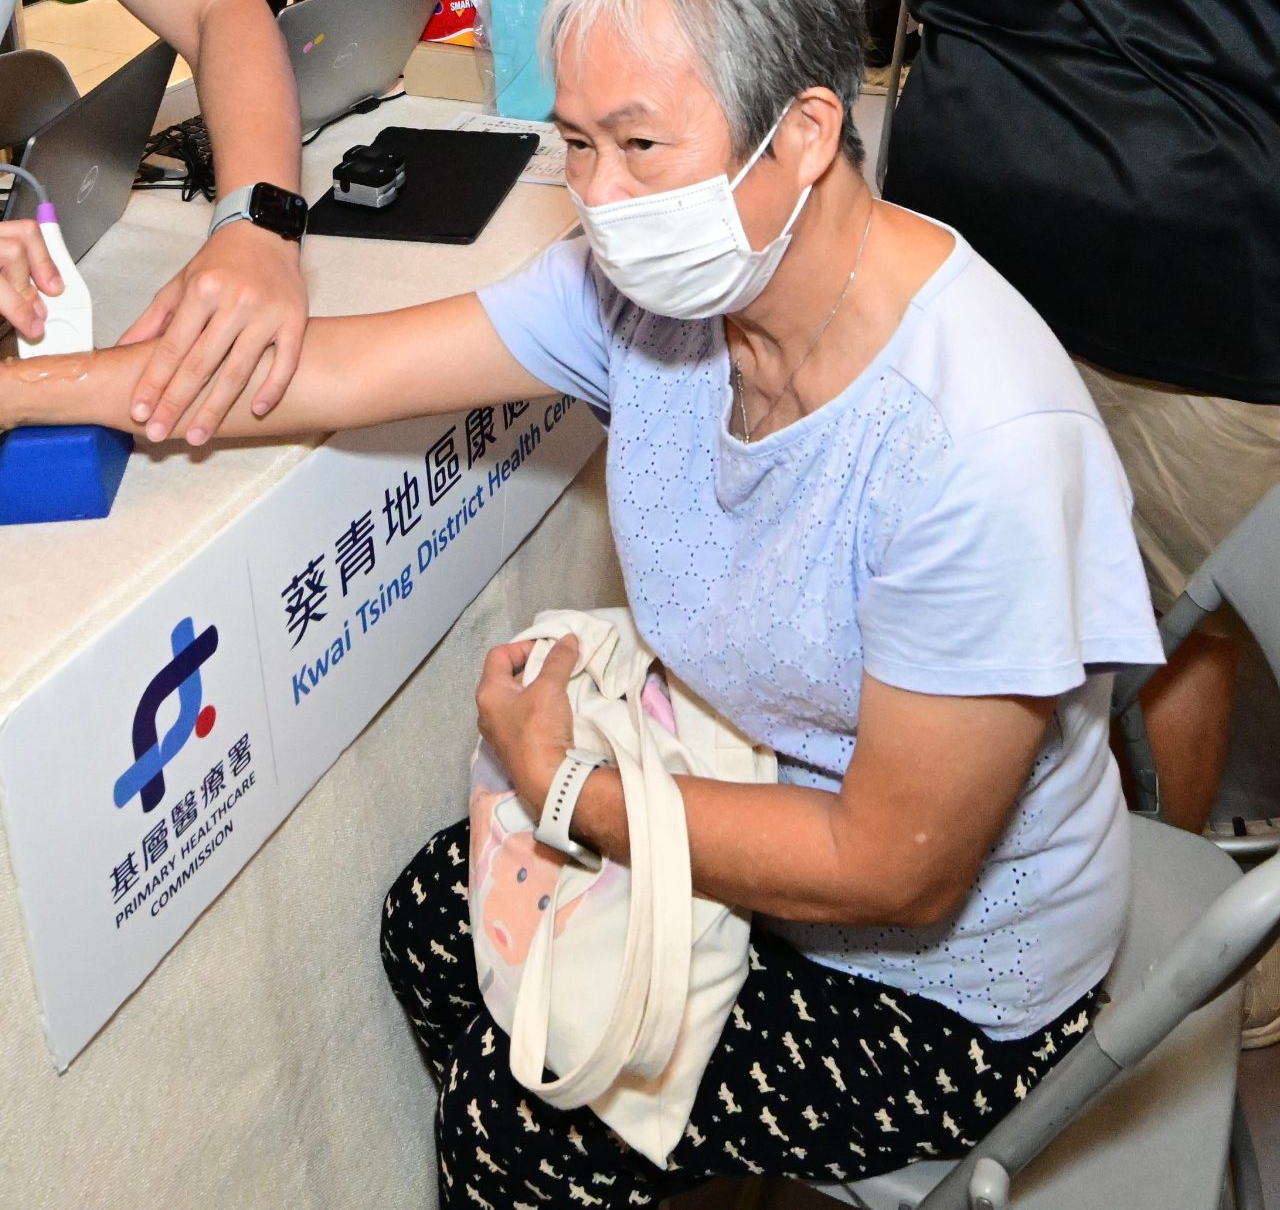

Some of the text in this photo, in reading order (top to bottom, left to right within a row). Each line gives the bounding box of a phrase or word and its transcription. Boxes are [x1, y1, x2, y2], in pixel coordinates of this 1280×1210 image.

[292, 620, 352, 706] Kwai
[355, 563, 414, 634] Tsing
[417, 485, 485, 574] District
[488, 423, 541, 497] Health
[110, 733, 252, 904] 基層醫療署
[115, 771, 256, 929] PRIMARY HEALTHCARE
[150, 820, 234, 917] COMMISSION
